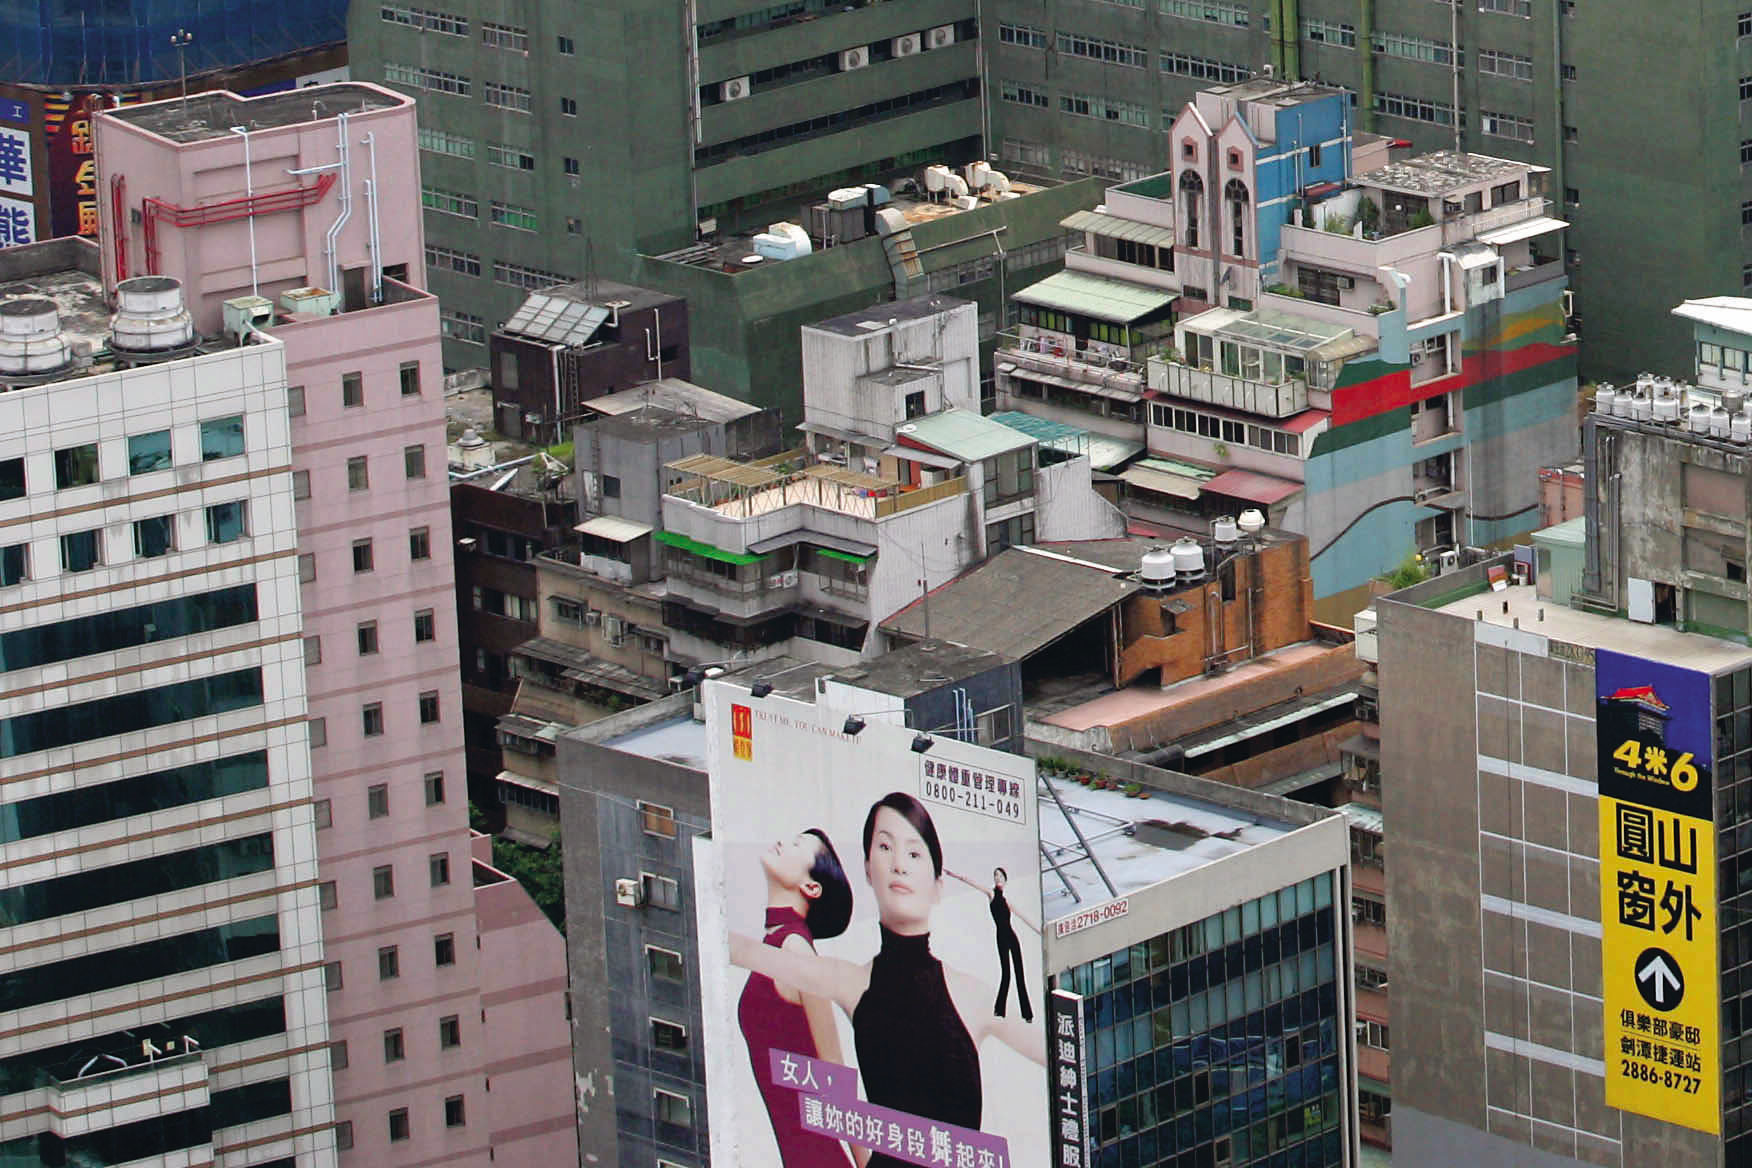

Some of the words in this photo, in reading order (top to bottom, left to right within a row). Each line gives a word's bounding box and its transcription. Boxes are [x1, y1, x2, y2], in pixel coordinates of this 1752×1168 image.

[926, 782, 1020, 818] 0800-211-049
[1616, 802, 1697, 875] 圓山
[1617, 870, 1702, 942] 窗外
[1621, 1059, 1702, 1094] 2886-8727
